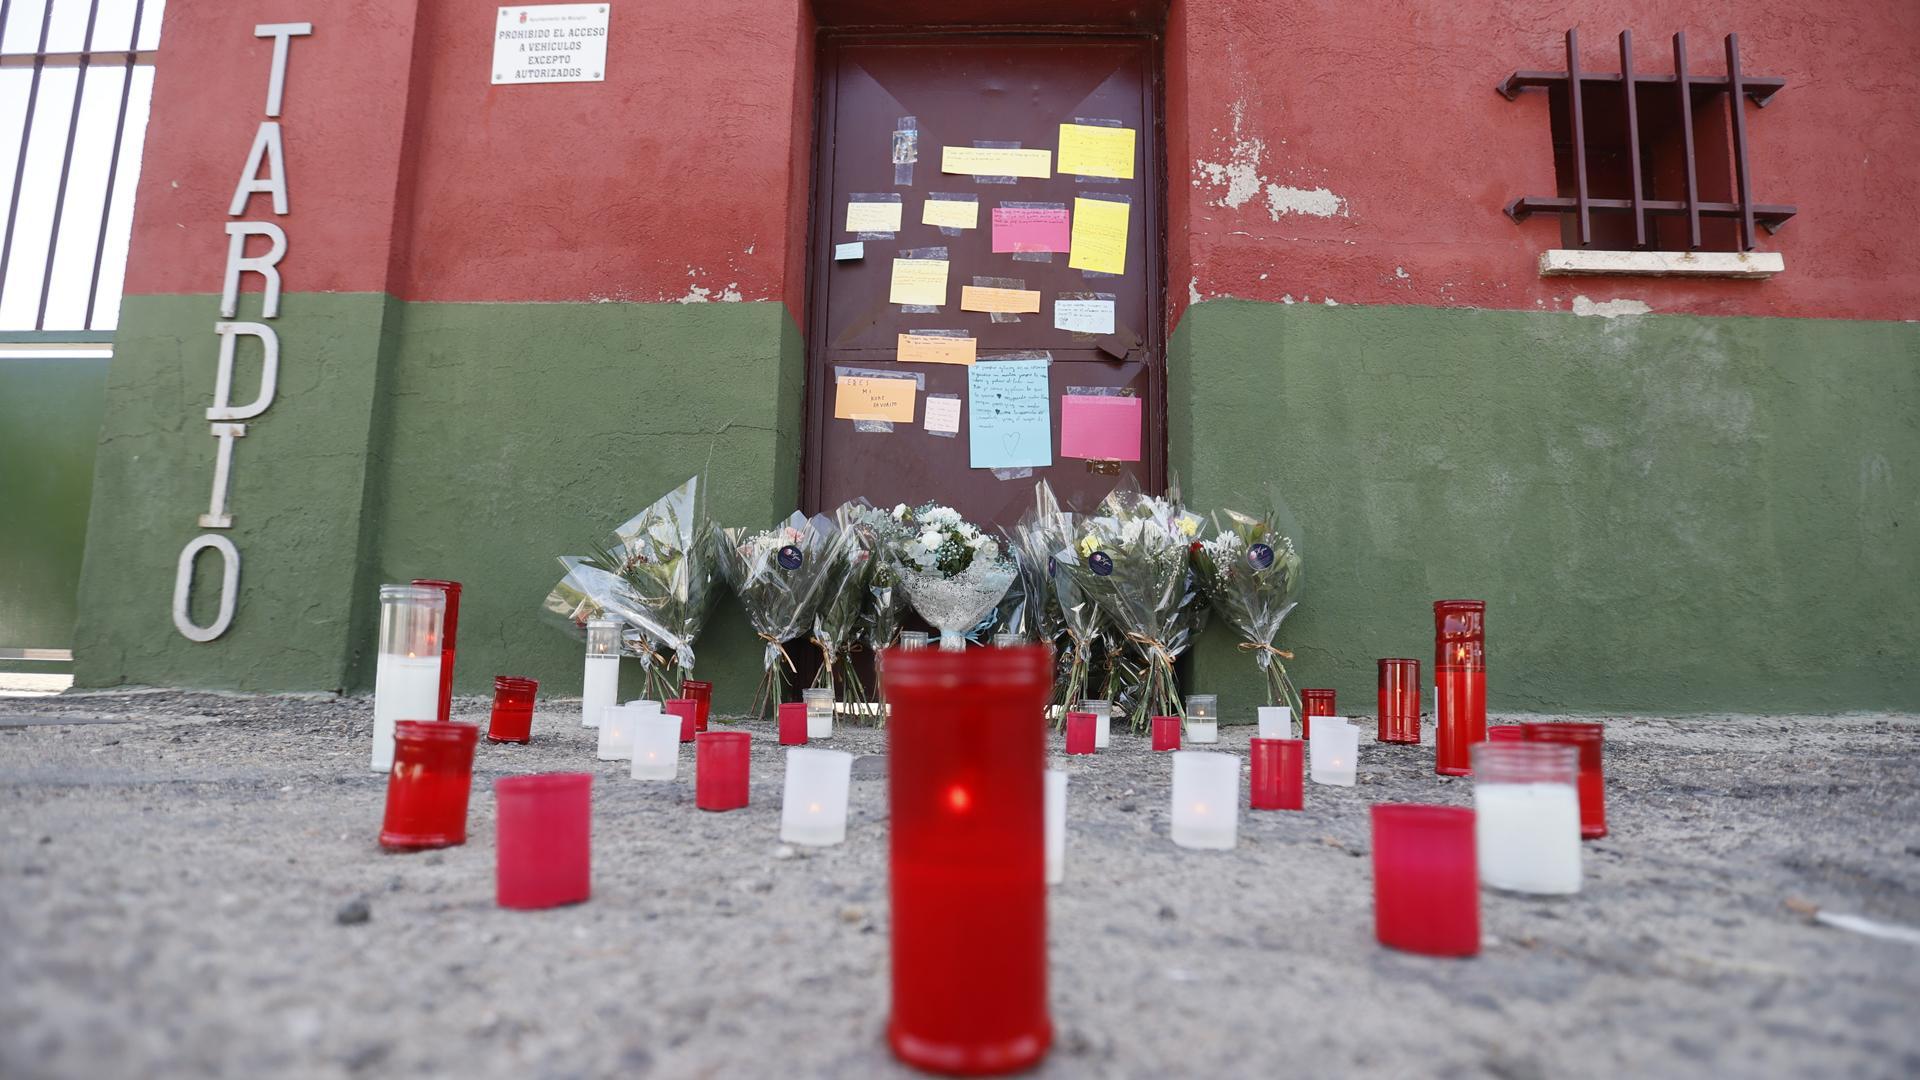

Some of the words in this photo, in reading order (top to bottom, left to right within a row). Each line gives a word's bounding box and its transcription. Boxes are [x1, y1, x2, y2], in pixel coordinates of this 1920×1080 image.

[499, 29, 550, 39] PROHIBIDO
[553, 28, 566, 38] EL
[567, 27, 606, 38] ACCESO
[519, 43, 526, 52] A
[528, 55, 572, 65] EXCEPTO
[514, 68, 582, 79] AUTORIZADOS
